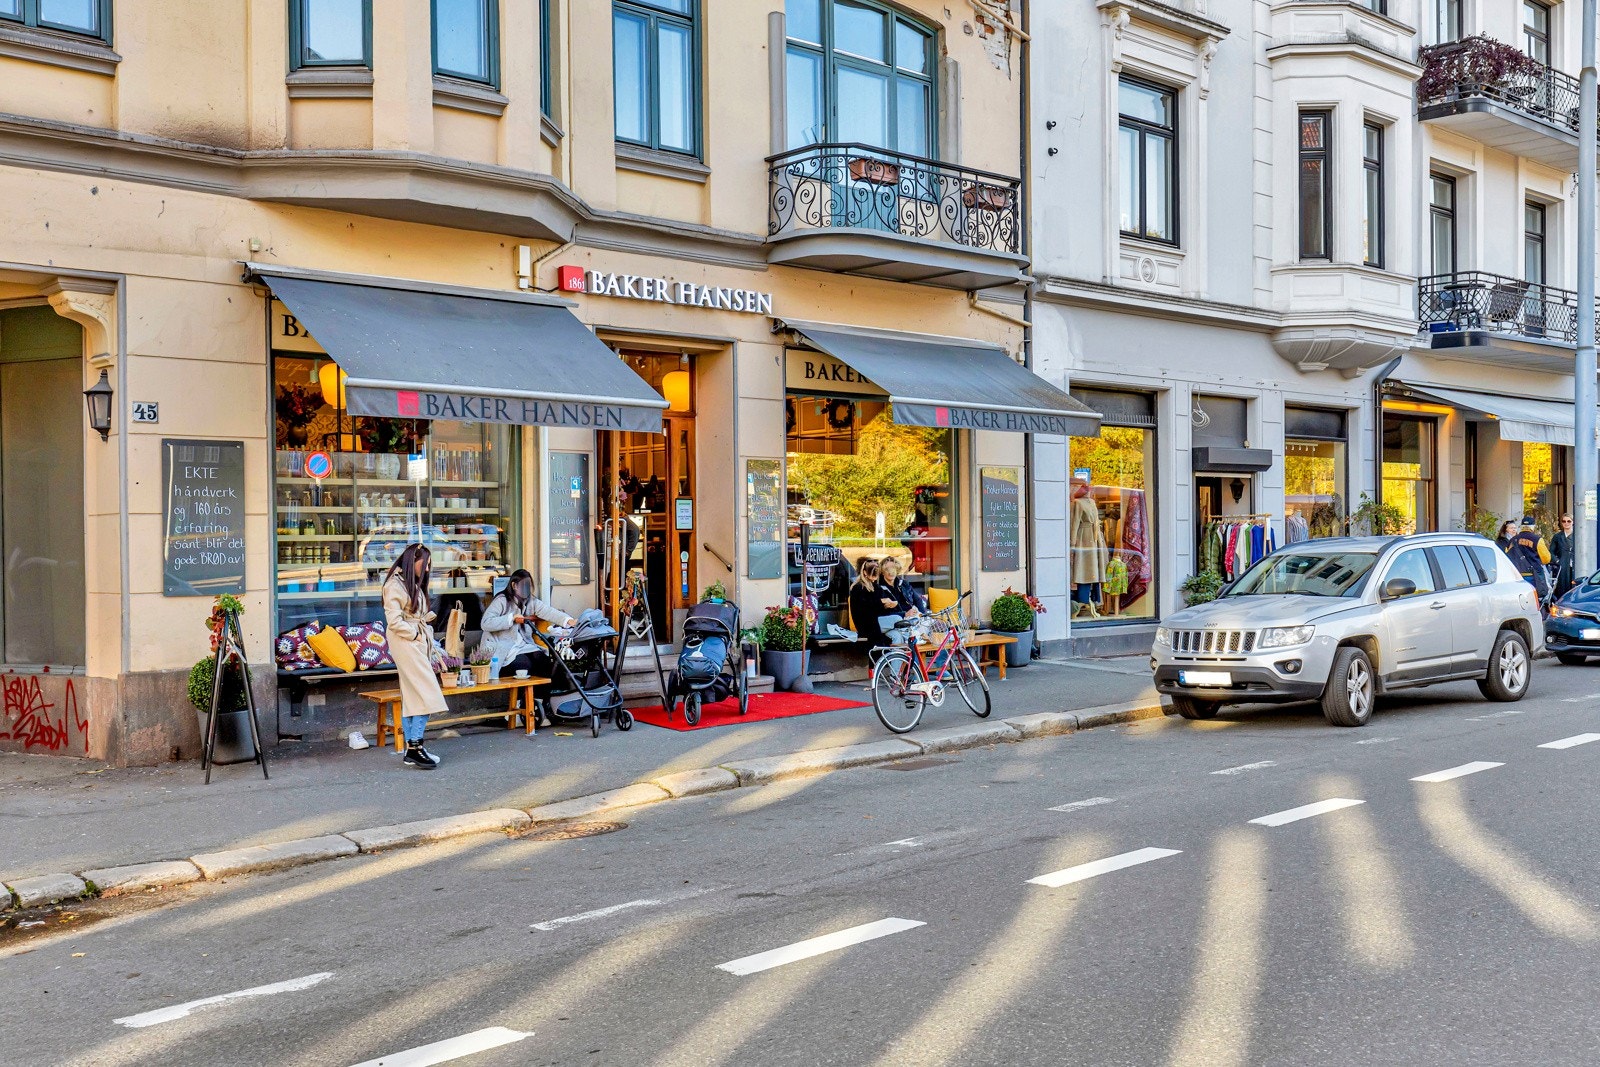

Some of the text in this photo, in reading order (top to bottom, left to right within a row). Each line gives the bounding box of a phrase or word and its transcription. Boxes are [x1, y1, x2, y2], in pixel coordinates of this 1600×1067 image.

[569, 277, 585, 290] 1861
[590, 270, 773, 315] BAKER HANSEN
[134, 403, 157, 421] 45
[425, 394, 512, 421] BAKER
[521, 401, 623, 428] HANSEN
[951, 408, 1001, 430] BAKER
[1006, 412, 1067, 433] HANSEN
[185, 466, 219, 479] EKTE
[174, 485, 238, 499] håndverk
[174, 502, 231, 521] og 160 års
[174, 523, 229, 540] erfaring
[206, 538, 223, 549] blir
[228, 538, 245, 549] det
[174, 557, 198, 570] gode
[200, 552, 227, 565] BRØD
[797, 547, 838, 562] MRGENKAFFE
